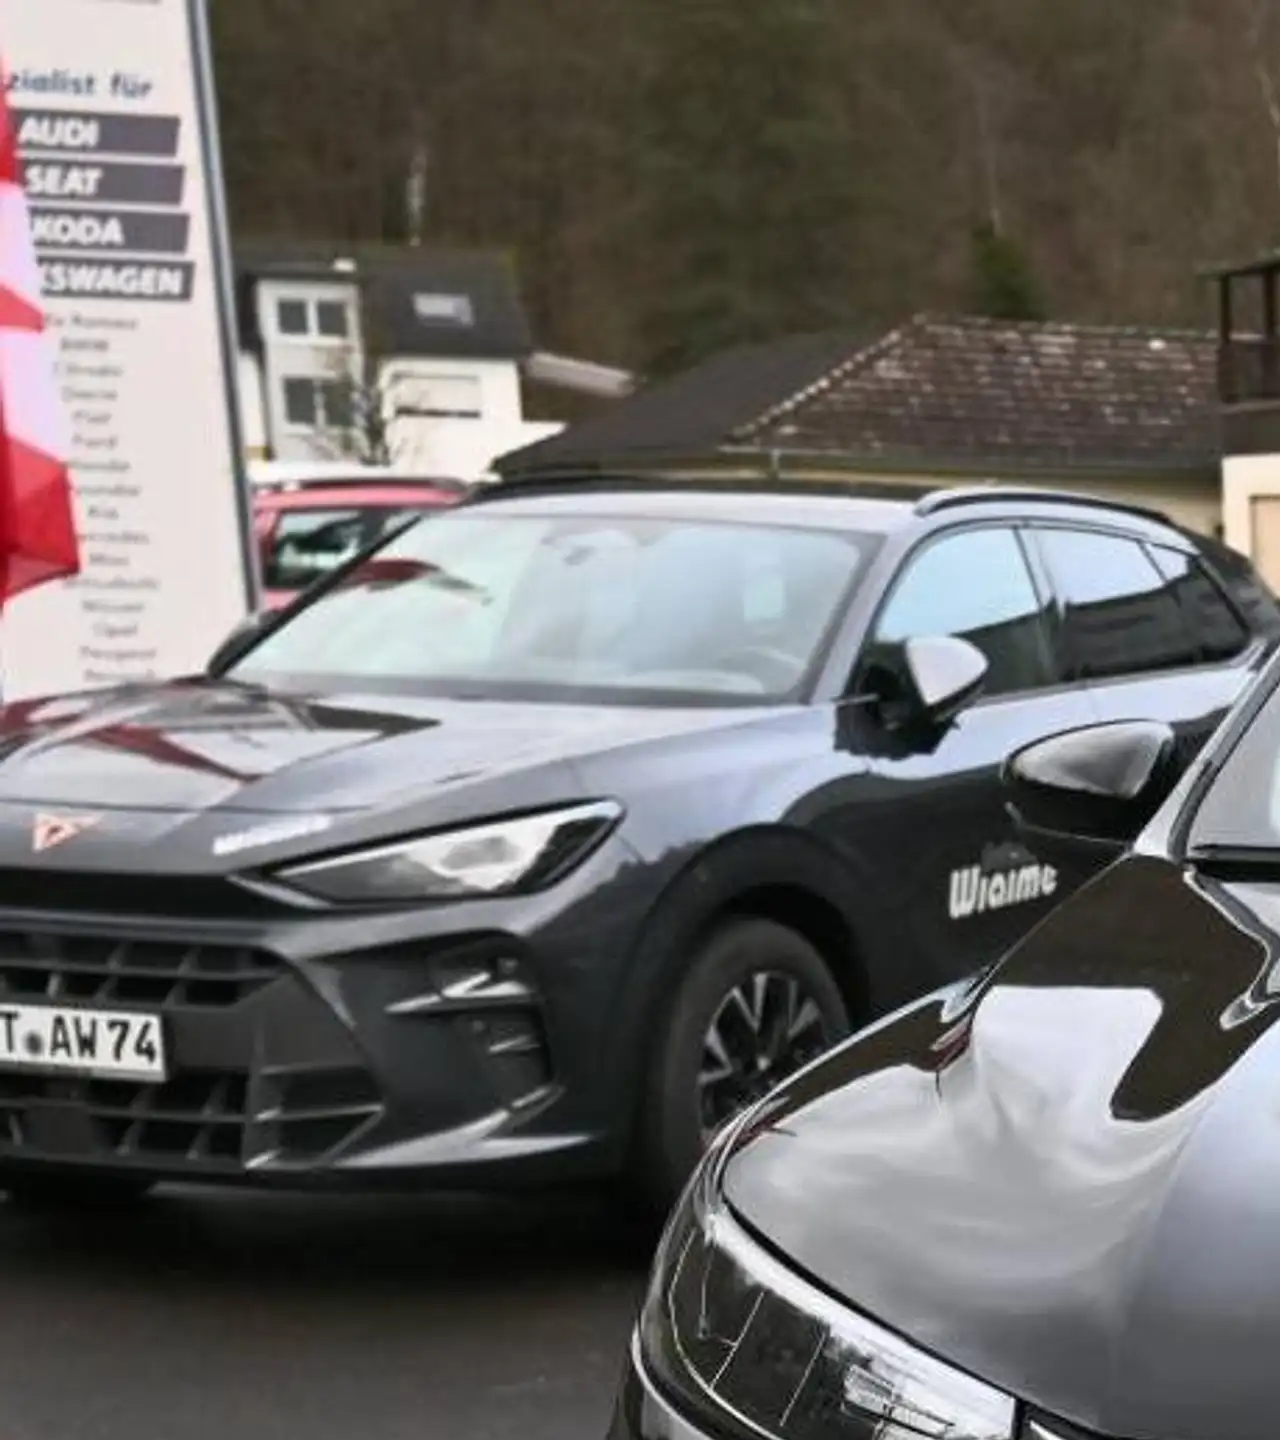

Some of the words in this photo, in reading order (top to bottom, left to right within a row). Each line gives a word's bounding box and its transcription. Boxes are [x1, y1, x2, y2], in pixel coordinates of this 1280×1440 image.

[18, 116, 99, 147] AUDI
[25, 165, 101, 195] SEAT
[32, 213, 124, 247] KODA
